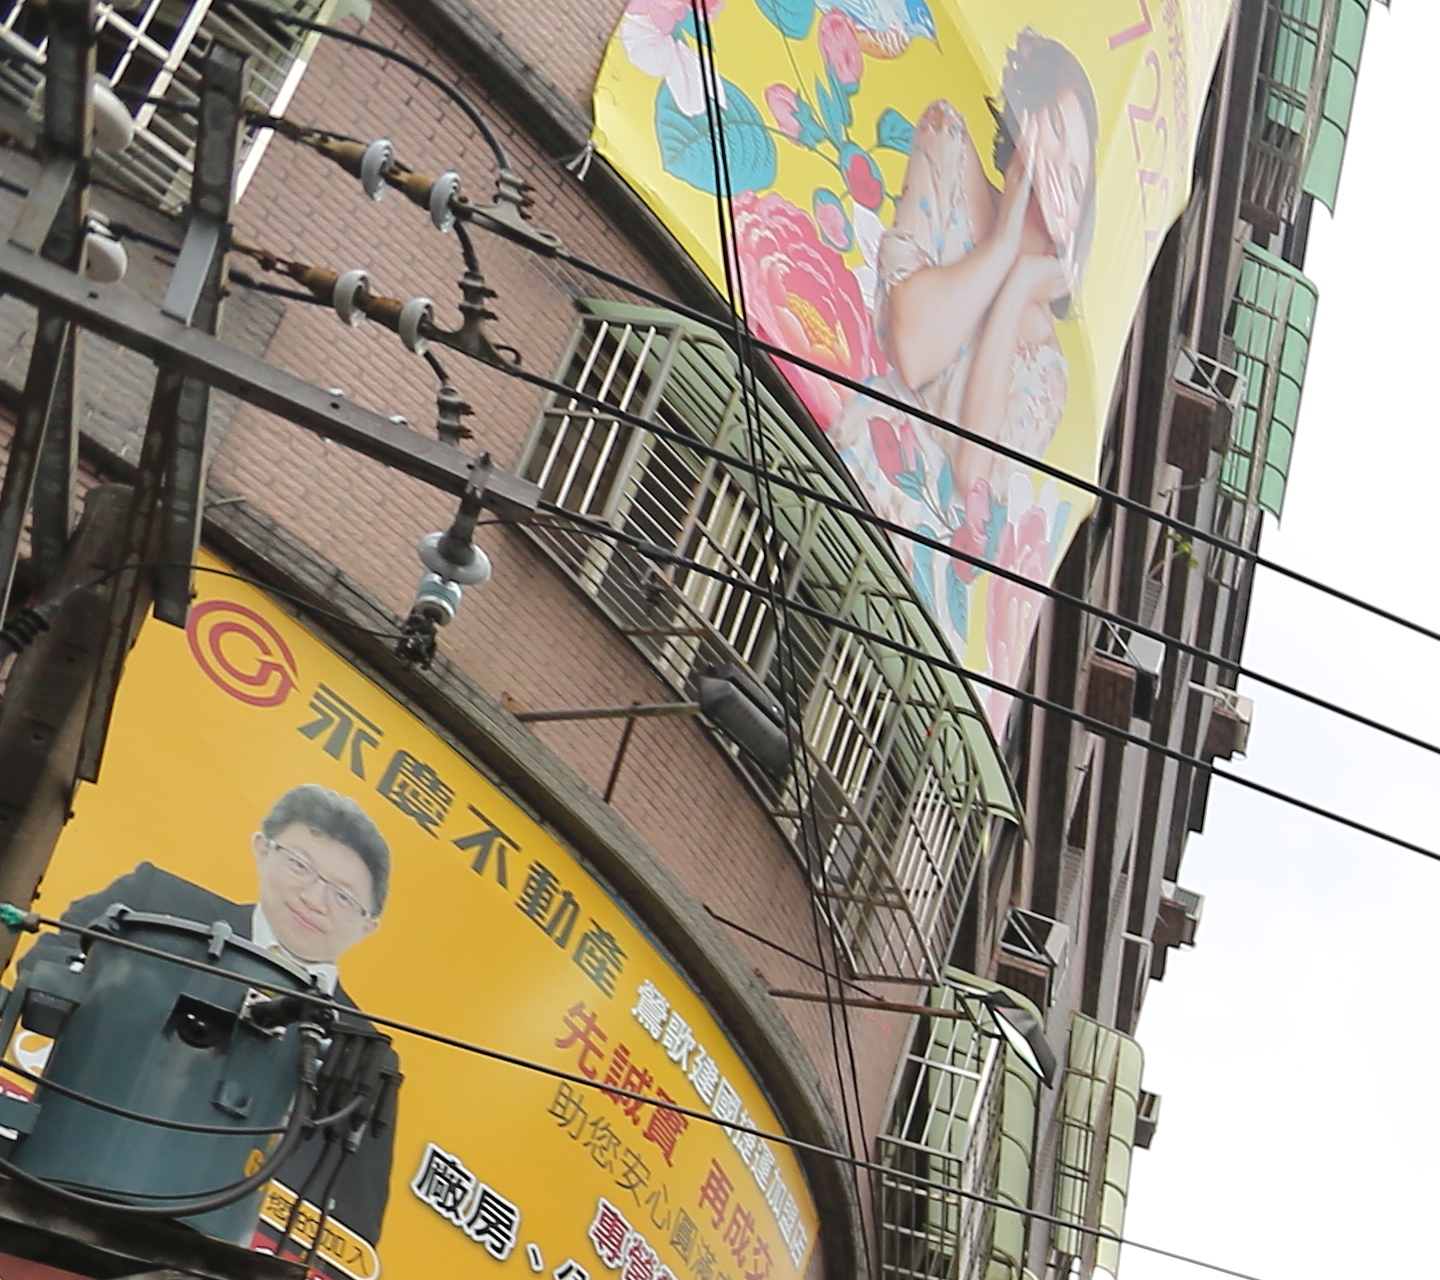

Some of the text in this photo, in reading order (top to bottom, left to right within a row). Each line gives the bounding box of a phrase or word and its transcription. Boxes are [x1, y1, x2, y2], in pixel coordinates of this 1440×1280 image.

[298, 681, 634, 999] 永慶不動產
